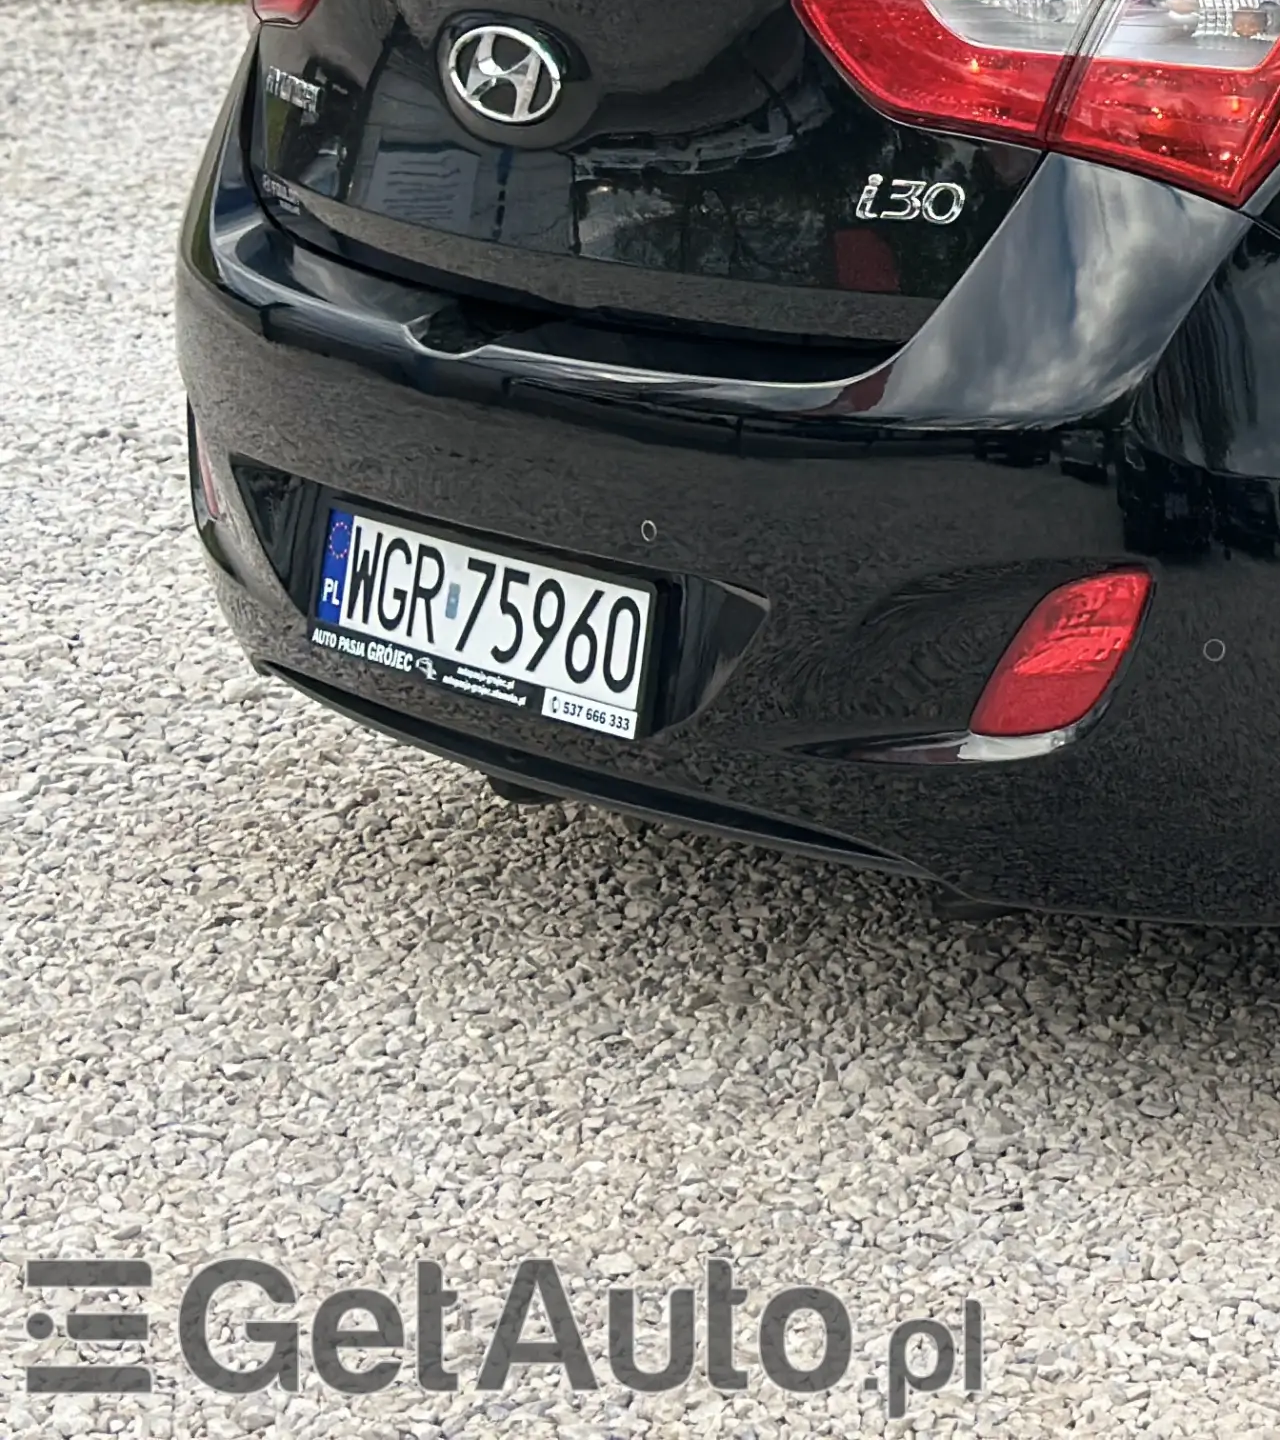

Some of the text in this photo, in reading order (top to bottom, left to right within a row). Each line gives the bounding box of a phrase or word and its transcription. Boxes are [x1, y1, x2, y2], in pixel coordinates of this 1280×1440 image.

[855, 173, 965, 224] i30
[322, 577, 340, 606] PL
[346, 525, 641, 693] WGR 75960
[311, 628, 337, 648] AUTO
[367, 642, 413, 672] GRÓJEC
[563, 702, 630, 731] 537 666 333
